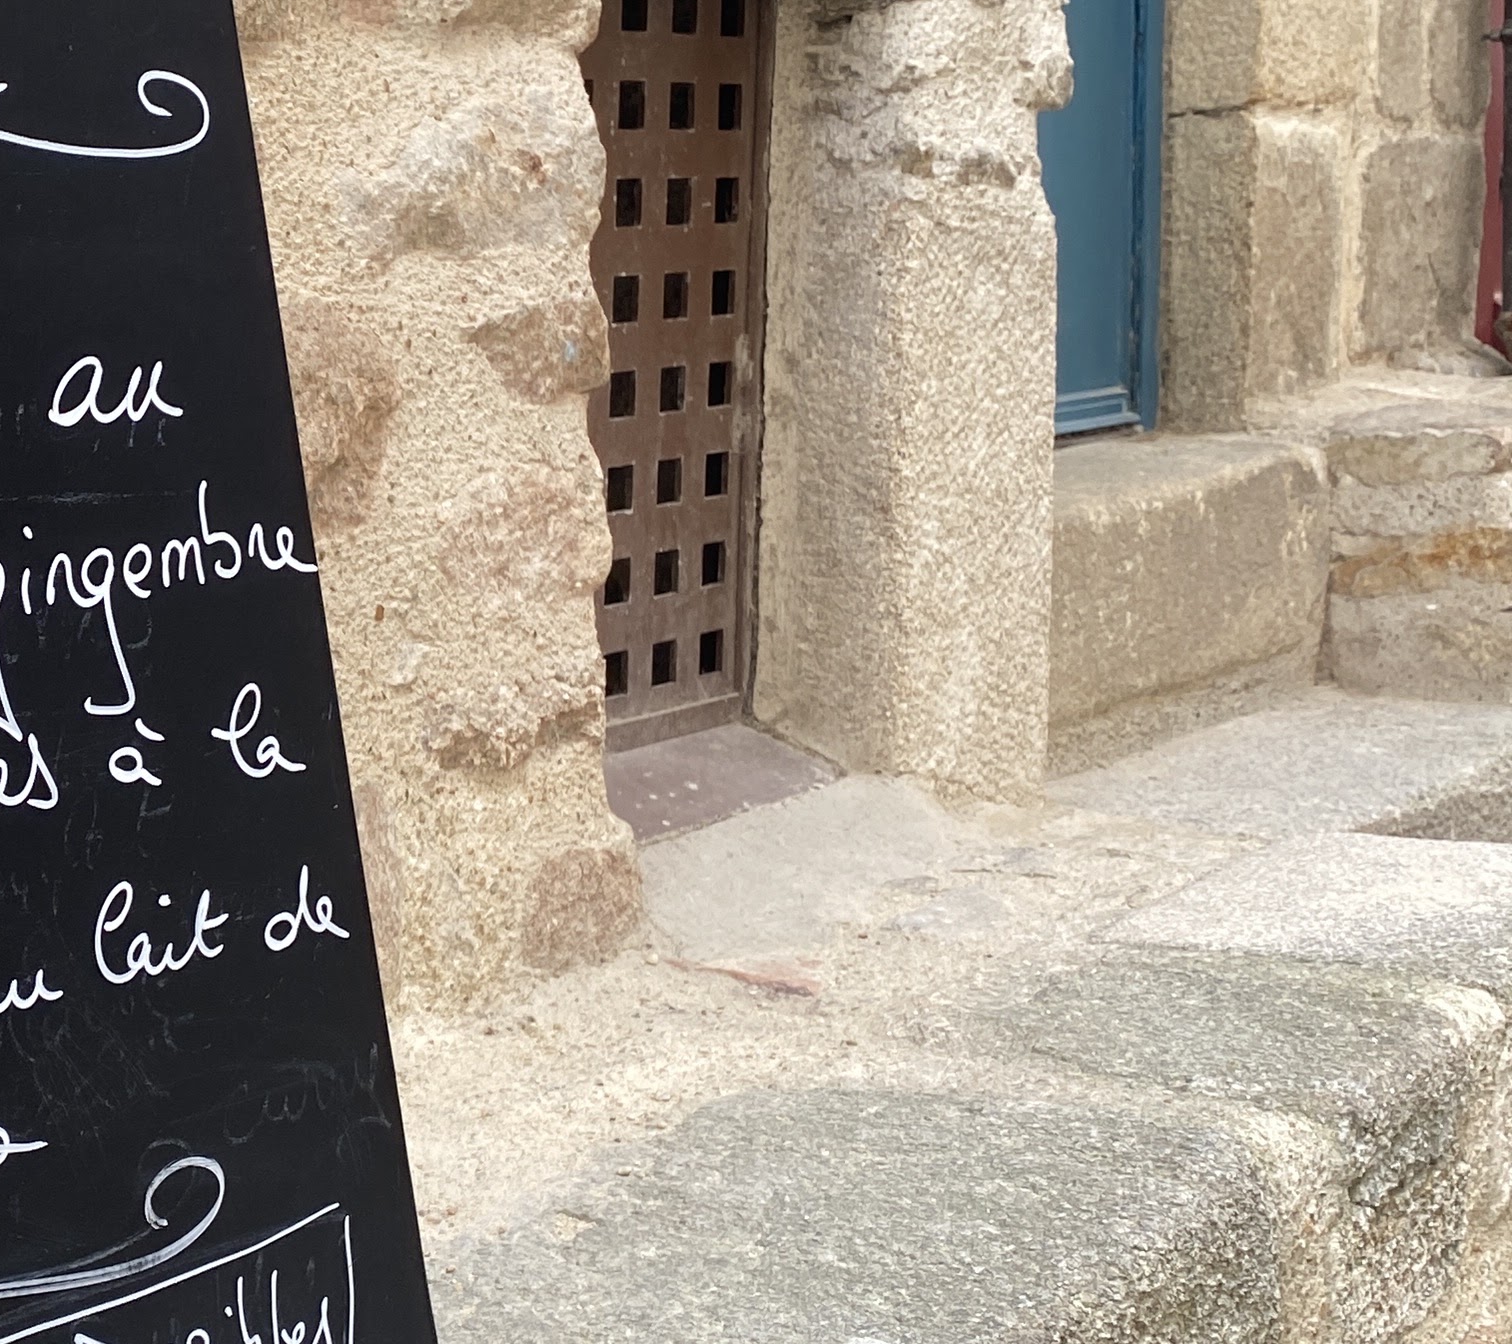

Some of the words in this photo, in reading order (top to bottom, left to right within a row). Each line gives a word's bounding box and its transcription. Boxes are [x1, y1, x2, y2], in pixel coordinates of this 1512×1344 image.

[48, 354, 185, 428] au
[106, 718, 165, 786] à
[212, 681, 308, 778] la
[93, 880, 229, 985] lait
[264, 864, 351, 952] de
